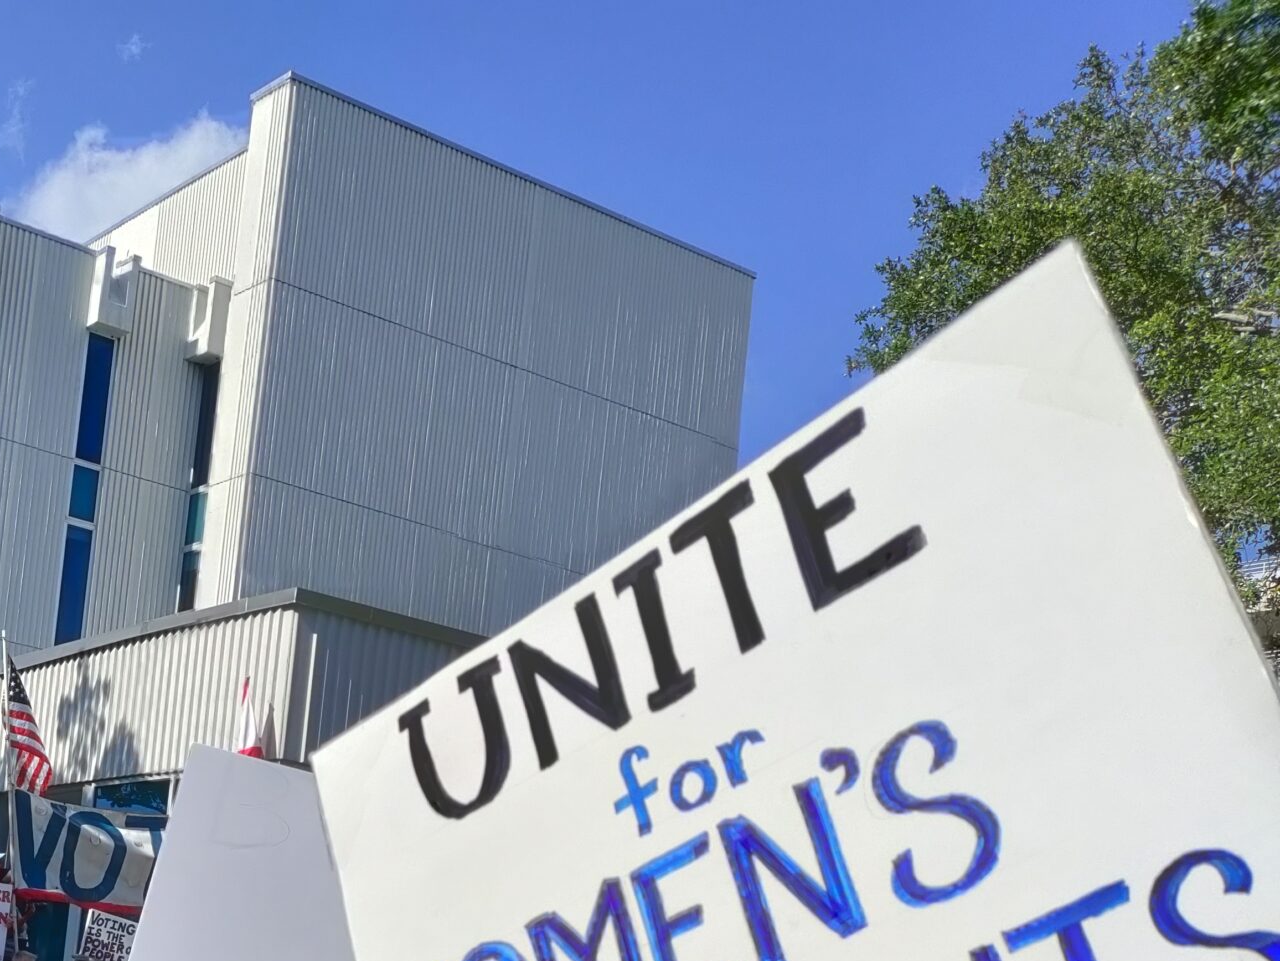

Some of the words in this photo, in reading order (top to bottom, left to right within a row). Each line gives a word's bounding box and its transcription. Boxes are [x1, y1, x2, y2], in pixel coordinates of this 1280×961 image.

[398, 406, 927, 820] UNITE
[614, 727, 765, 836] for
[87, 926, 102, 938] IS
[106, 931, 126, 944] THE
[91, 911, 136, 936] VOTING
[85, 936, 124, 954] POWER
